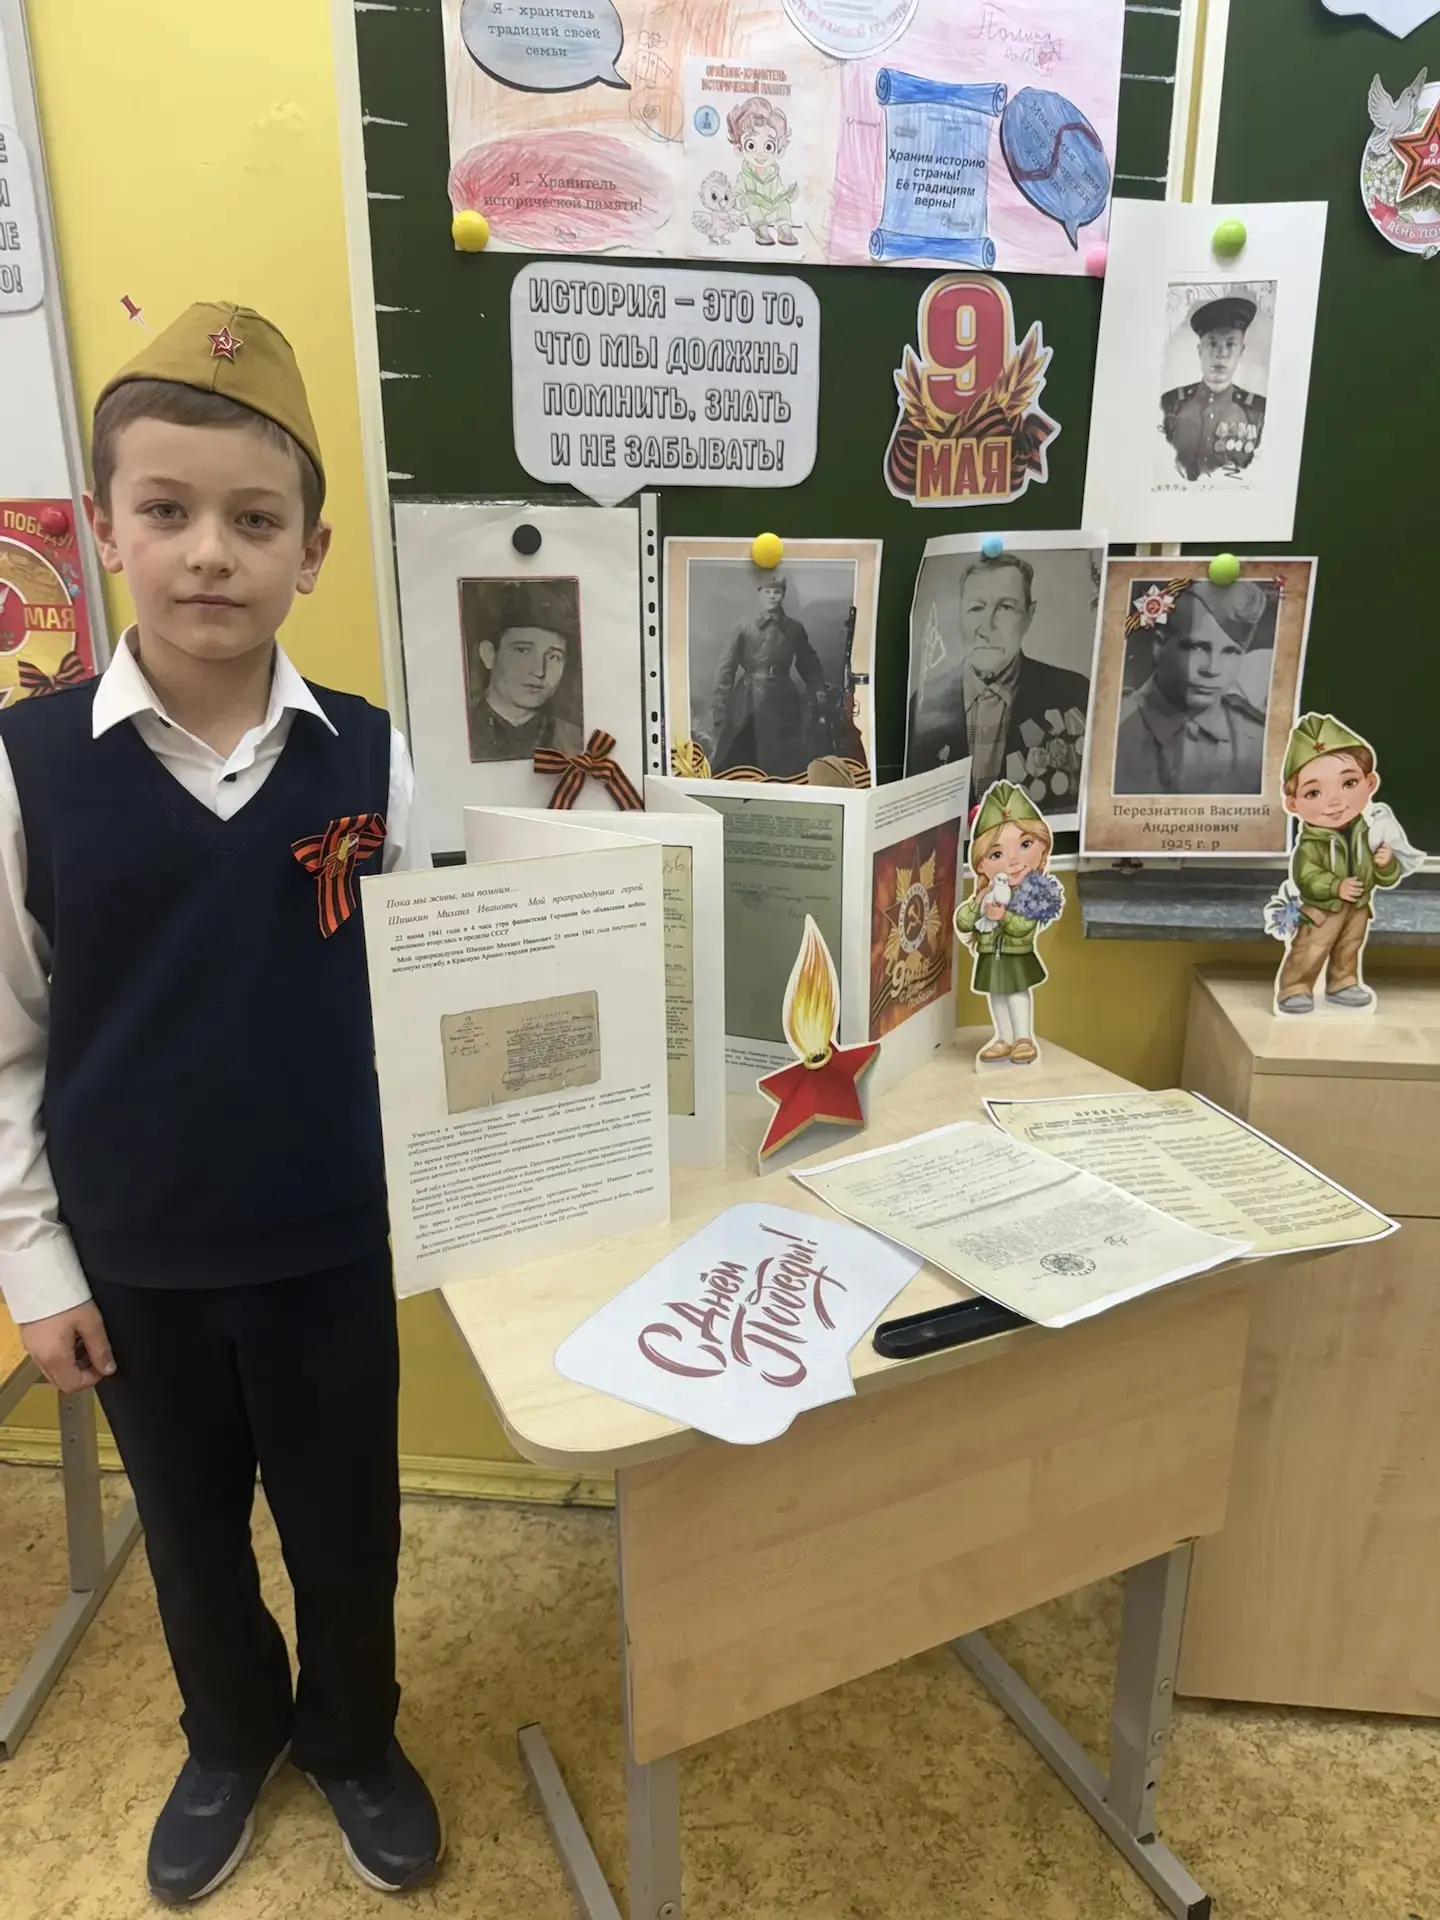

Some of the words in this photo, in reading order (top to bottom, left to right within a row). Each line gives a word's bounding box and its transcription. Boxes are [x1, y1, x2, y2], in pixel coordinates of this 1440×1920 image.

[492, 2, 503, 15] Я
[519, 4, 595, 21] хранитель
[487, 23, 560, 38] традиций
[564, 27, 601, 40] своей
[525, 44, 568, 57] семьи
[888, 148, 934, 165] Храним
[934, 152, 986, 171] историю
[1428, 142, 1439, 158] 9
[509, 172, 521, 188] Я
[537, 173, 617, 191] Хранитель
[912, 166, 962, 182] страны!
[895, 177, 910, 192] Её
[911, 181, 975, 198] традициям
[483, 194, 581, 211] исторической
[582, 197, 643, 212] памяти!
[914, 195, 957, 210] верны!
[1387, 220, 1416, 239] ДЕНЬ
[529, 277, 667, 319] ИСТОРИЯ
[702, 287, 754, 323] ЭТО
[762, 291, 804, 328] ТО,
[534, 331, 590, 366] ЧТО
[600, 334, 659, 369] МЫ
[666, 337, 799, 375] ДОЛЖНЫ
[926, 282, 1005, 415] 9
[543, 382, 696, 422] ПОМНИТЬ,
[704, 389, 792, 423] ЗНАТЬ
[550, 433, 571, 466] И
[580, 434, 616, 467] НЕ
[624, 436, 785, 471] ЗАБЫВАТЬ!
[917, 438, 1009, 500] МАЯ
[24, 606, 76, 630] МАЯ
[1112, 804, 1206, 821] Перезнатнов
[1209, 803, 1271, 817] Василий
[1141, 820, 1239, 836] Андреянович
[1160, 839, 1193, 850] 1925
[386, 899, 410, 908] Пока
[428, 894, 457, 902] живы,
[387, 914, 428, 925] Шишкин
[436, 909, 470, 918] Михаил
[528, 896, 545, 906] Мой
[552, 889, 614, 904] прапрадедушка
[428, 928, 442, 937] 1941
[494, 920, 508, 929] утра
[396, 954, 411, 962] Мой
[581, 927, 594, 935] 1941
[729, 1222, 849, 1388] Победы!
